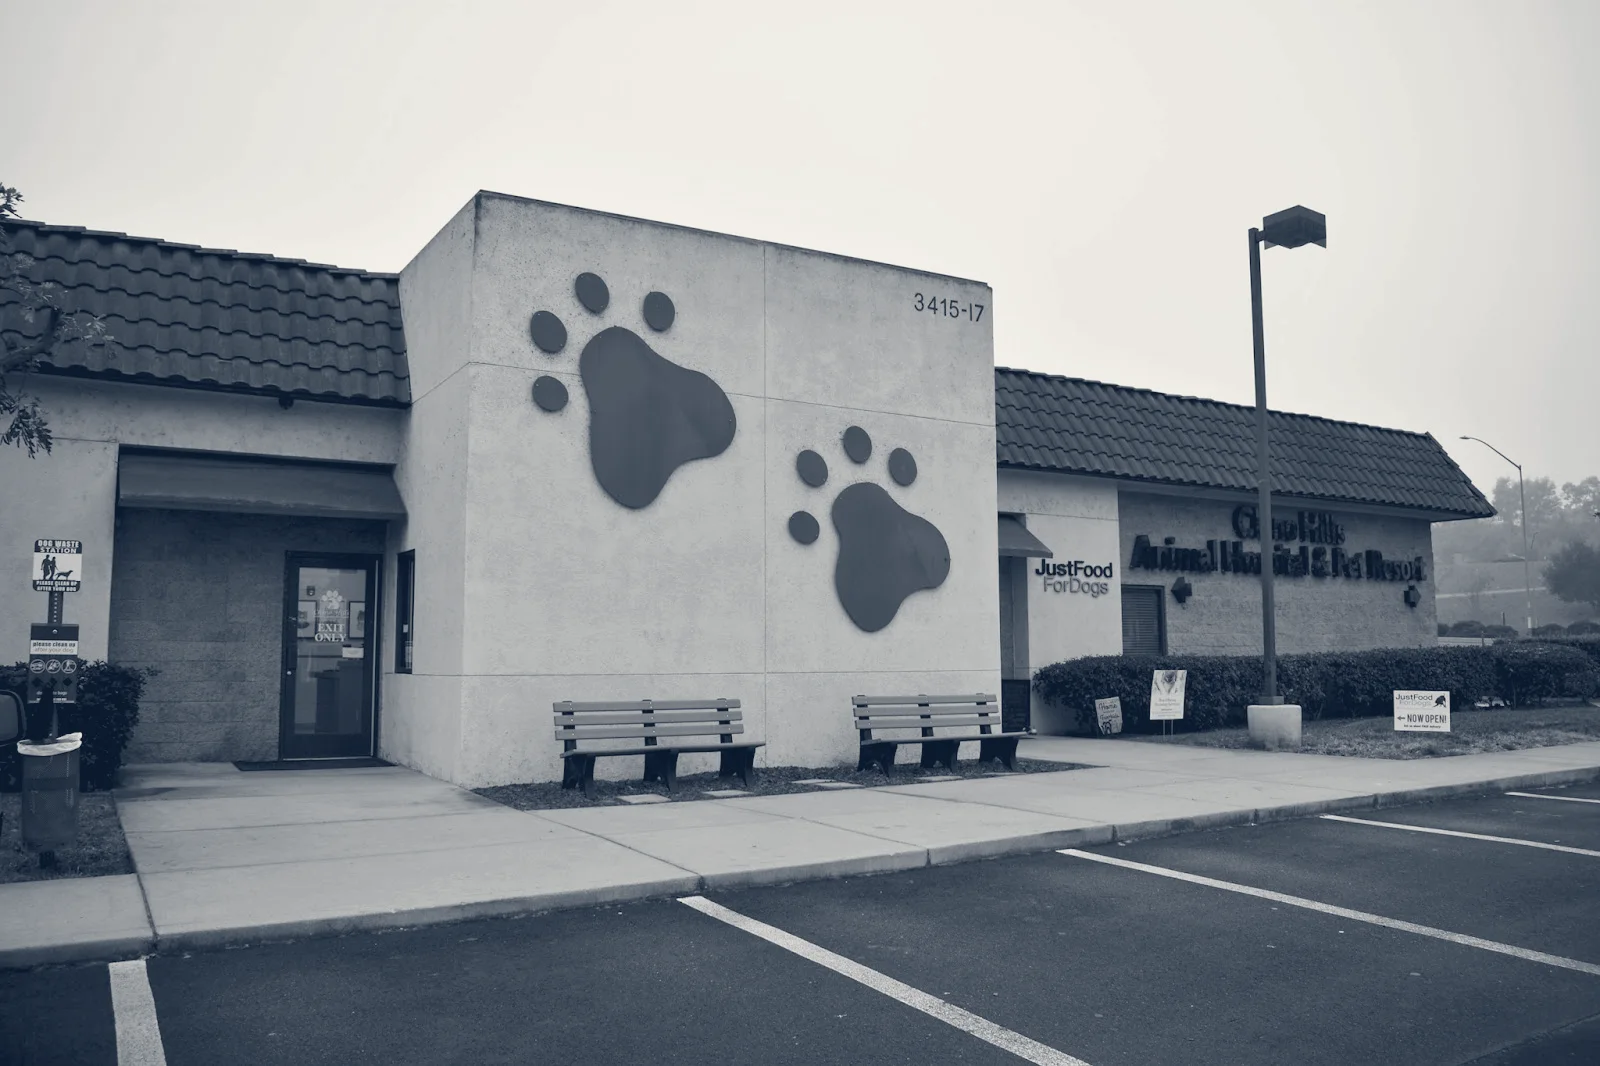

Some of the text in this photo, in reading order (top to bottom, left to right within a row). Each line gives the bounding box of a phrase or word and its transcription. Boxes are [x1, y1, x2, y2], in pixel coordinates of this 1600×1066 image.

[914, 292, 984, 322] 3415-17
[1298, 511, 1346, 545] Hills
[55, 540, 79, 548] WASTE
[1035, 558, 1112, 578] JustFood
[1128, 534, 1218, 573] Animal
[1311, 546, 1331, 577] &
[1331, 547, 1364, 580] Pet
[1365, 549, 1427, 582] Resort
[1043, 576, 1109, 598] ForDogs
[314, 633, 346, 642] ONLY
[318, 623, 346, 632] EXIT
[1407, 714, 1447, 724] NOW OPEN!
